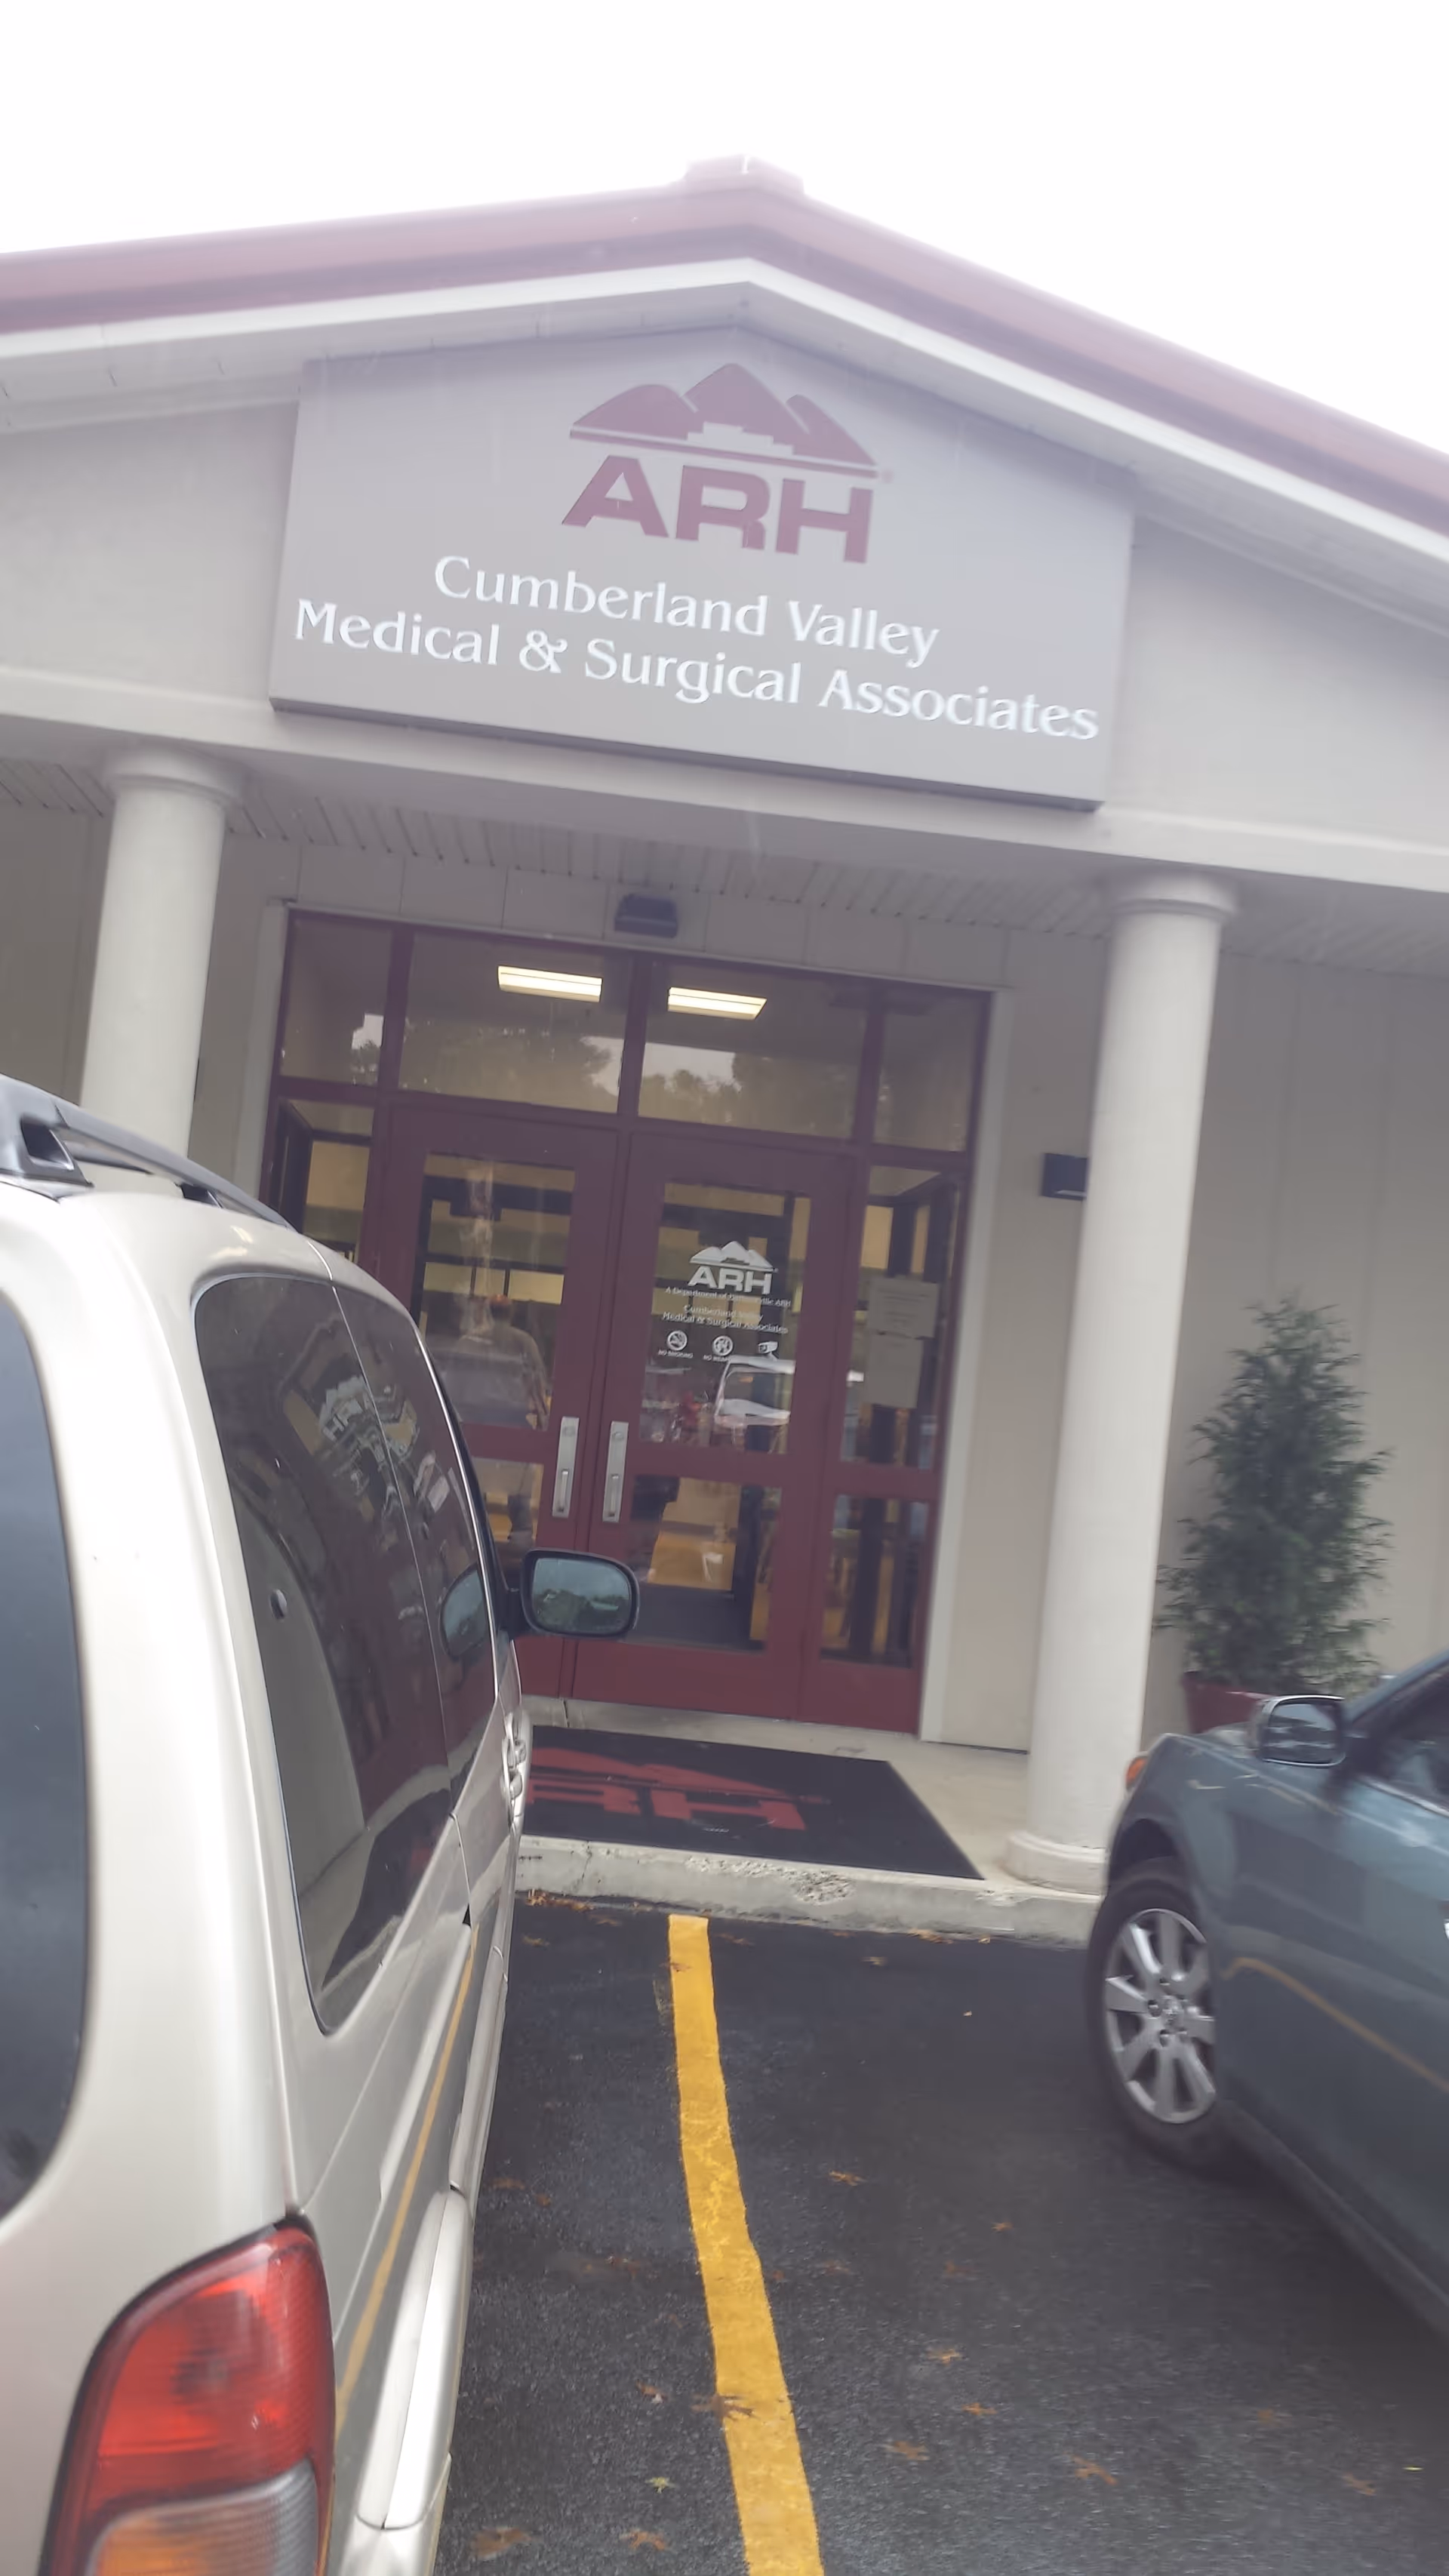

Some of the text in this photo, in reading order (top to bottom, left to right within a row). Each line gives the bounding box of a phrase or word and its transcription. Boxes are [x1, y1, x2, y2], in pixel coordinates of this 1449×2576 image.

[562, 454, 873, 564] ARH
[434, 556, 940, 669] Cumberland Valley
[296, 598, 1099, 740] Medical & Surgical Associates
[662, 1311, 695, 1323] Medical
[706, 1316, 742, 1329] Surgical
[688, 1265, 772, 1294] ARH
